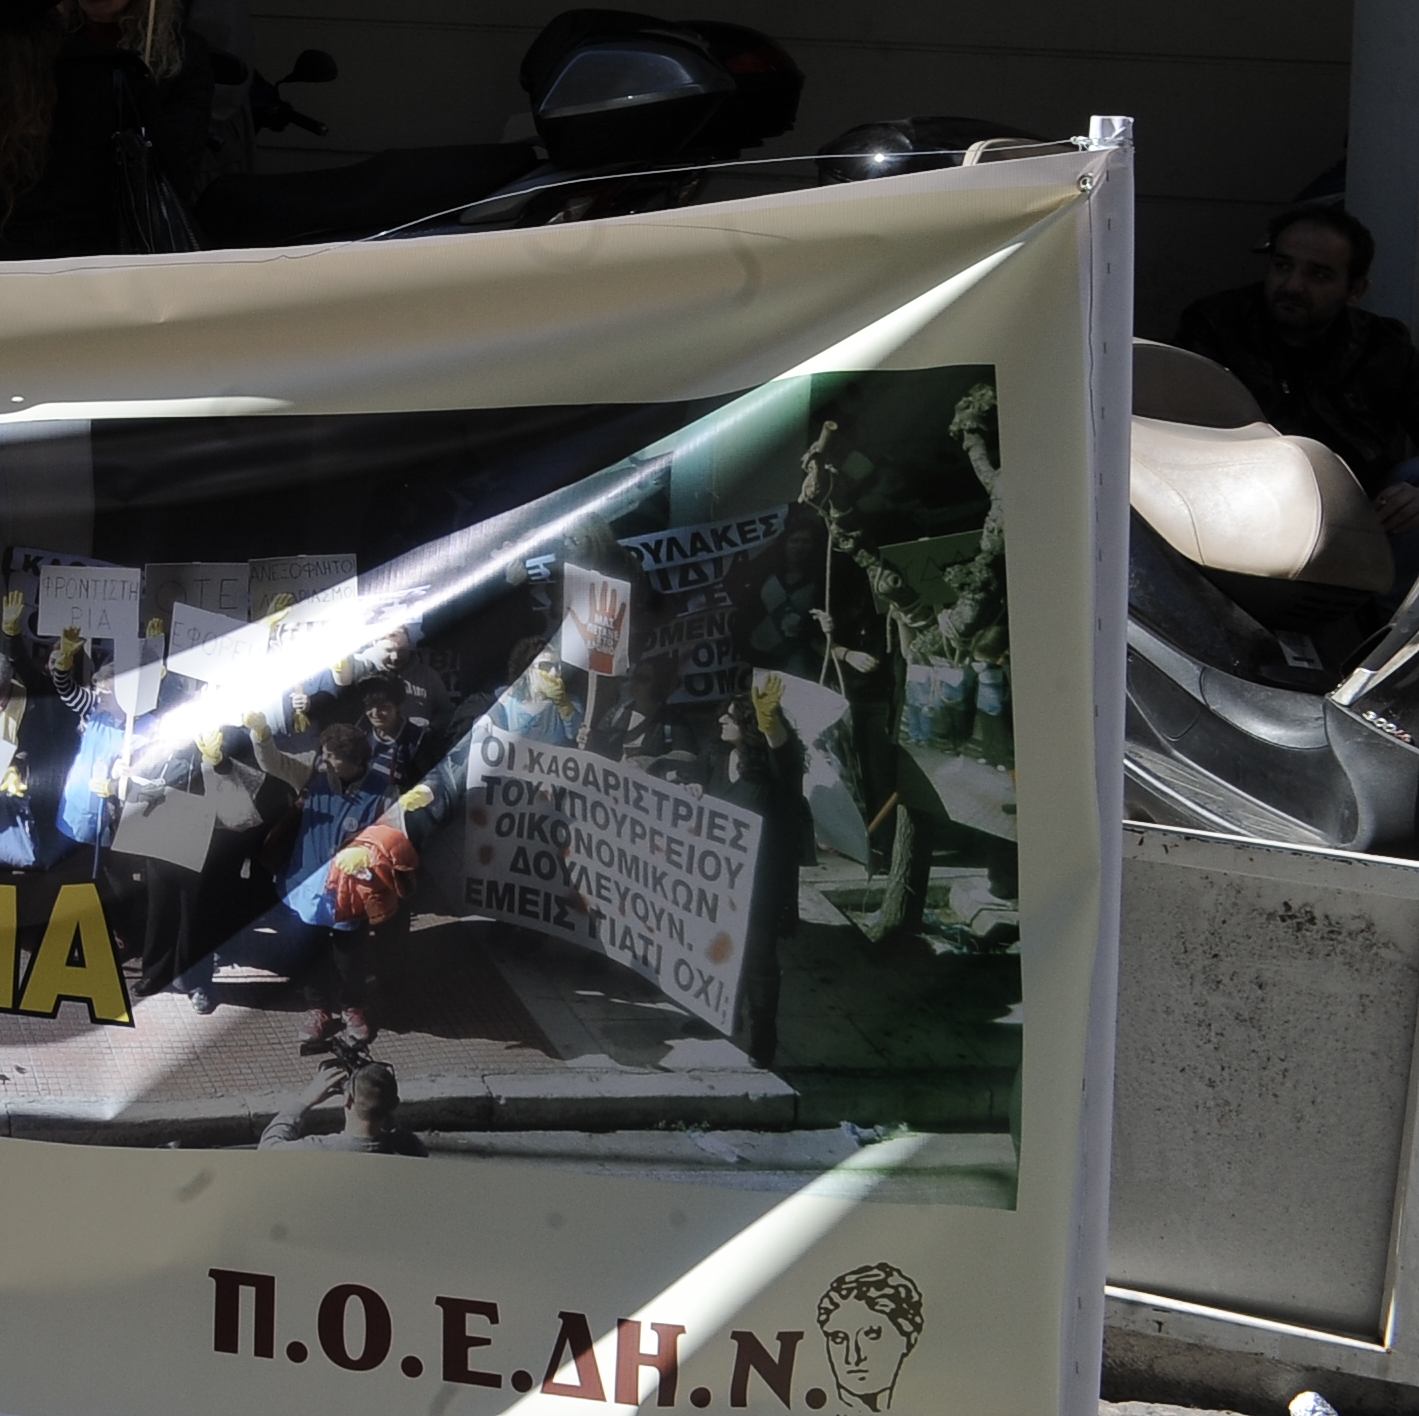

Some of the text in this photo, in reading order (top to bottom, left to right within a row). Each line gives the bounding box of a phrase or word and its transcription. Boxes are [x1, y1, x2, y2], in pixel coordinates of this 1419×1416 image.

[480, 735, 751, 854] ΟΙ ΚΑΘΑΡΙΣΤΡΙΕΣ
[480, 775, 745, 890] ΤΟΥ ΥΠΟΥΡΓΕΙΟΥ
[494, 811, 719, 923] ΟΙΚΟΝΟΜΙΚΩΝ
[465, 877, 730, 1026] ΕΜΕΙΣ ΓΙΑΤΙ ΟΧΙ;
